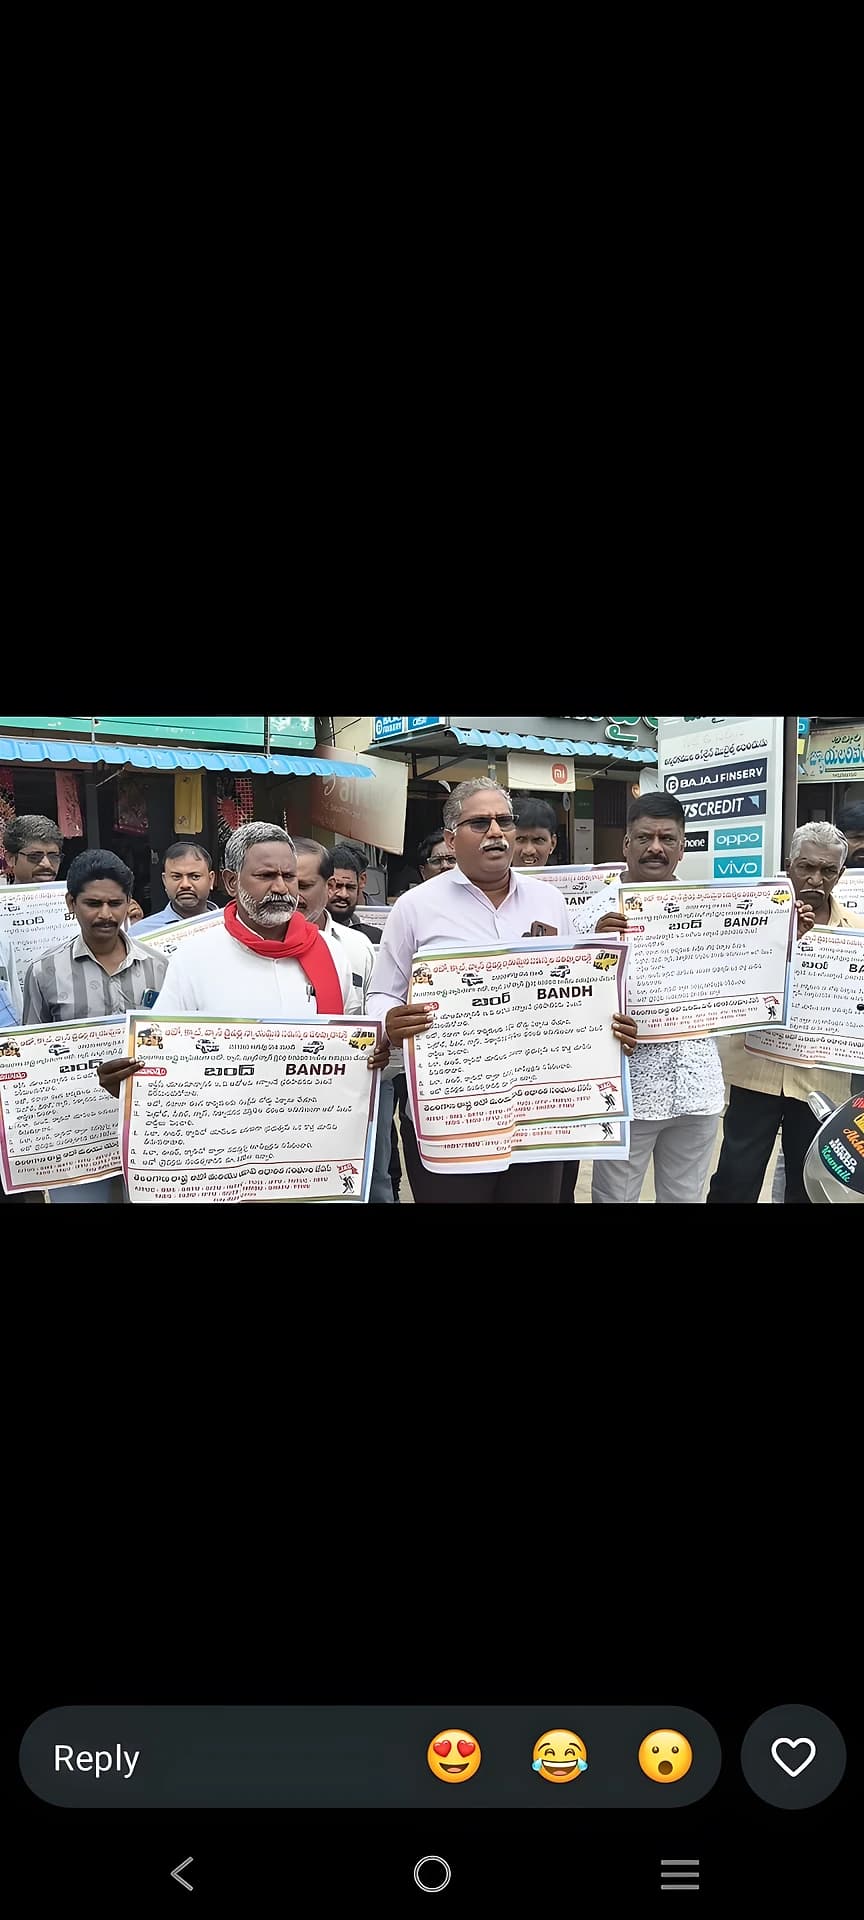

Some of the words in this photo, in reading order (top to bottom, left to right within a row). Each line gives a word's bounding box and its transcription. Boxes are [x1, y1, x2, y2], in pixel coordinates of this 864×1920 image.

[680, 774, 719, 788] BAJAJ
[720, 767, 764, 783] FINSERV
[682, 798, 744, 817] VSCREDIT
[716, 833, 760, 845] oppo
[717, 860, 758, 874] vivo
[668, 919, 702, 930] బంద్
[724, 917, 768, 928] BANDH
[537, 985, 593, 1000] BANDH
[472, 992, 511, 1007] బంద్
[204, 1064, 255, 1076] బంద్
[285, 1064, 346, 1076] BANDH
